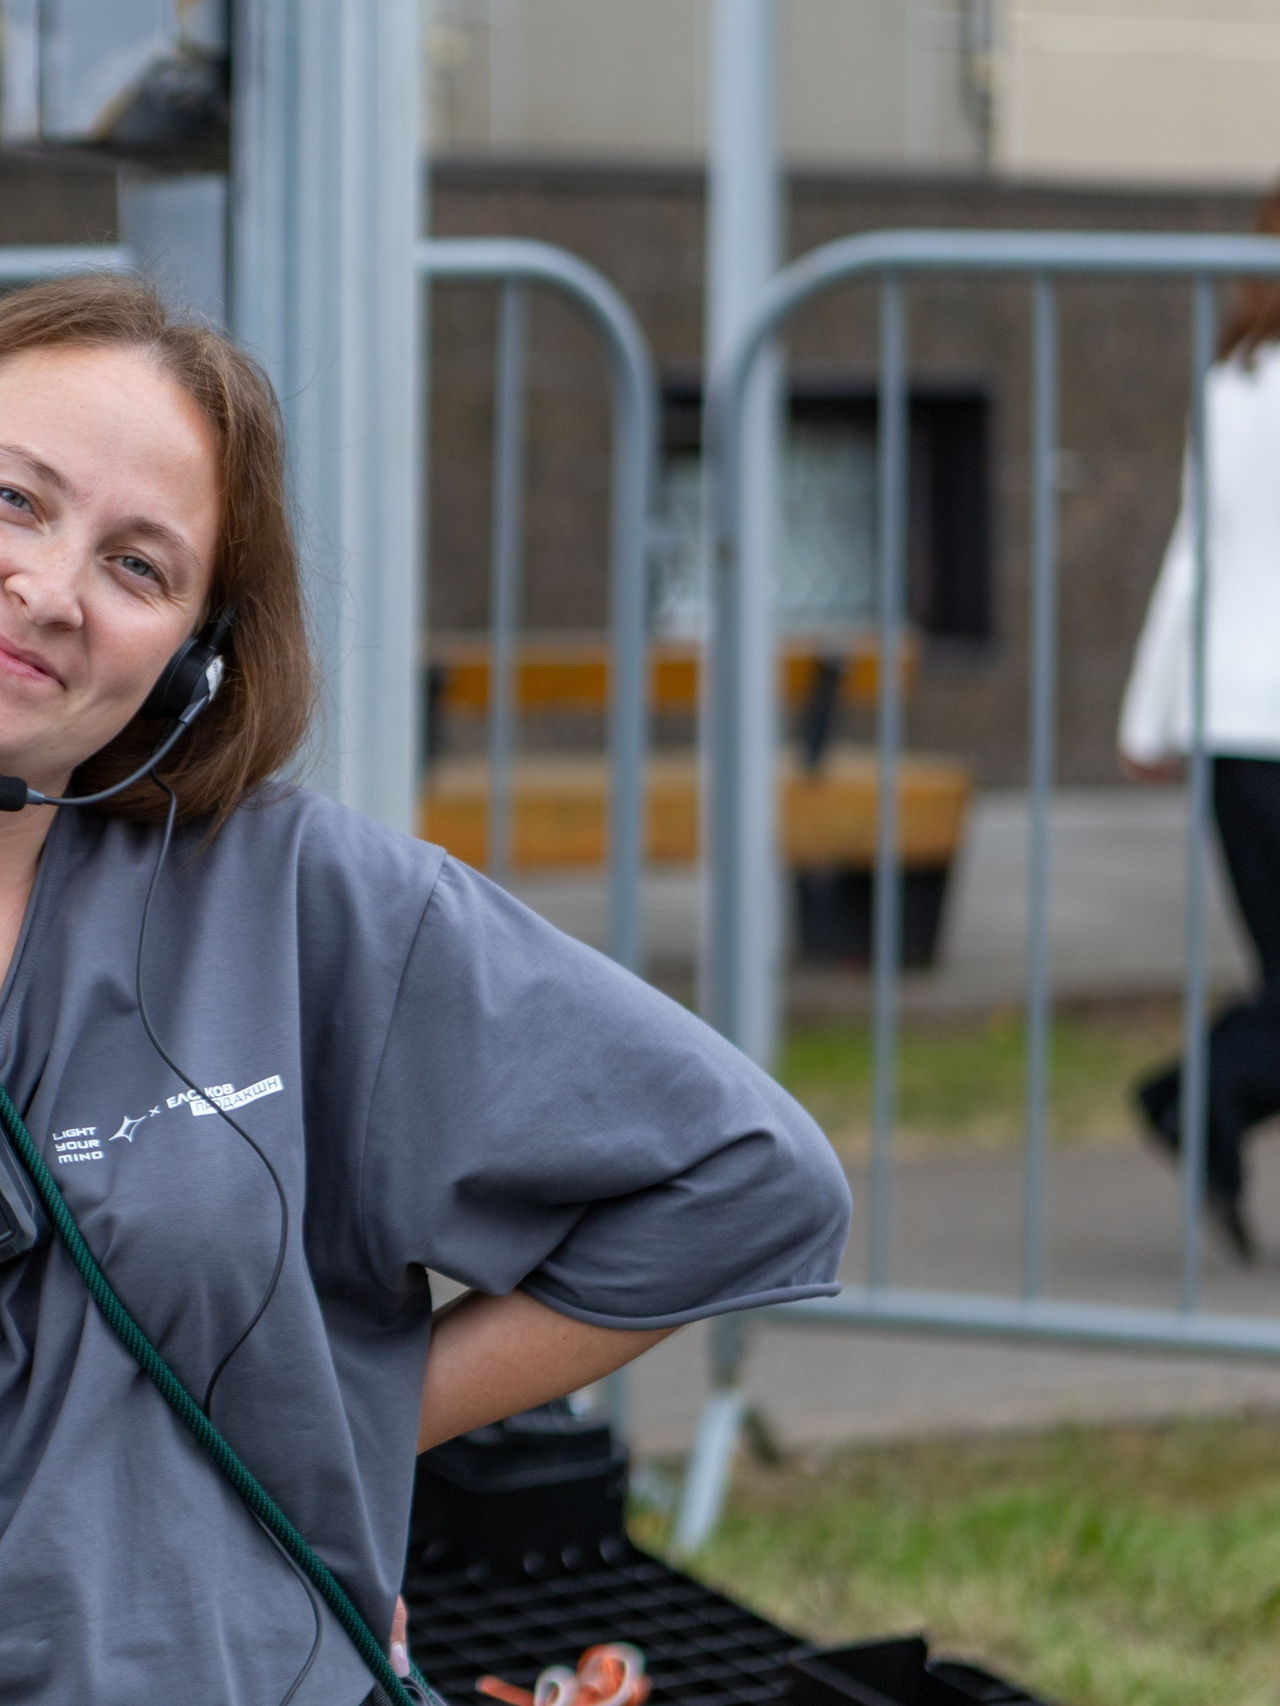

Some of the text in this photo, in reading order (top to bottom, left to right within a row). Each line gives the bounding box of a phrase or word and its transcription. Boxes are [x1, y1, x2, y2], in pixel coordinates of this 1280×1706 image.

[166, 1083, 234, 1109] ЕЛСКОВ
[52, 1126, 97, 1140] LIGHT
[55, 1139, 100, 1152] YOUR
[58, 1150, 104, 1164] MIND
